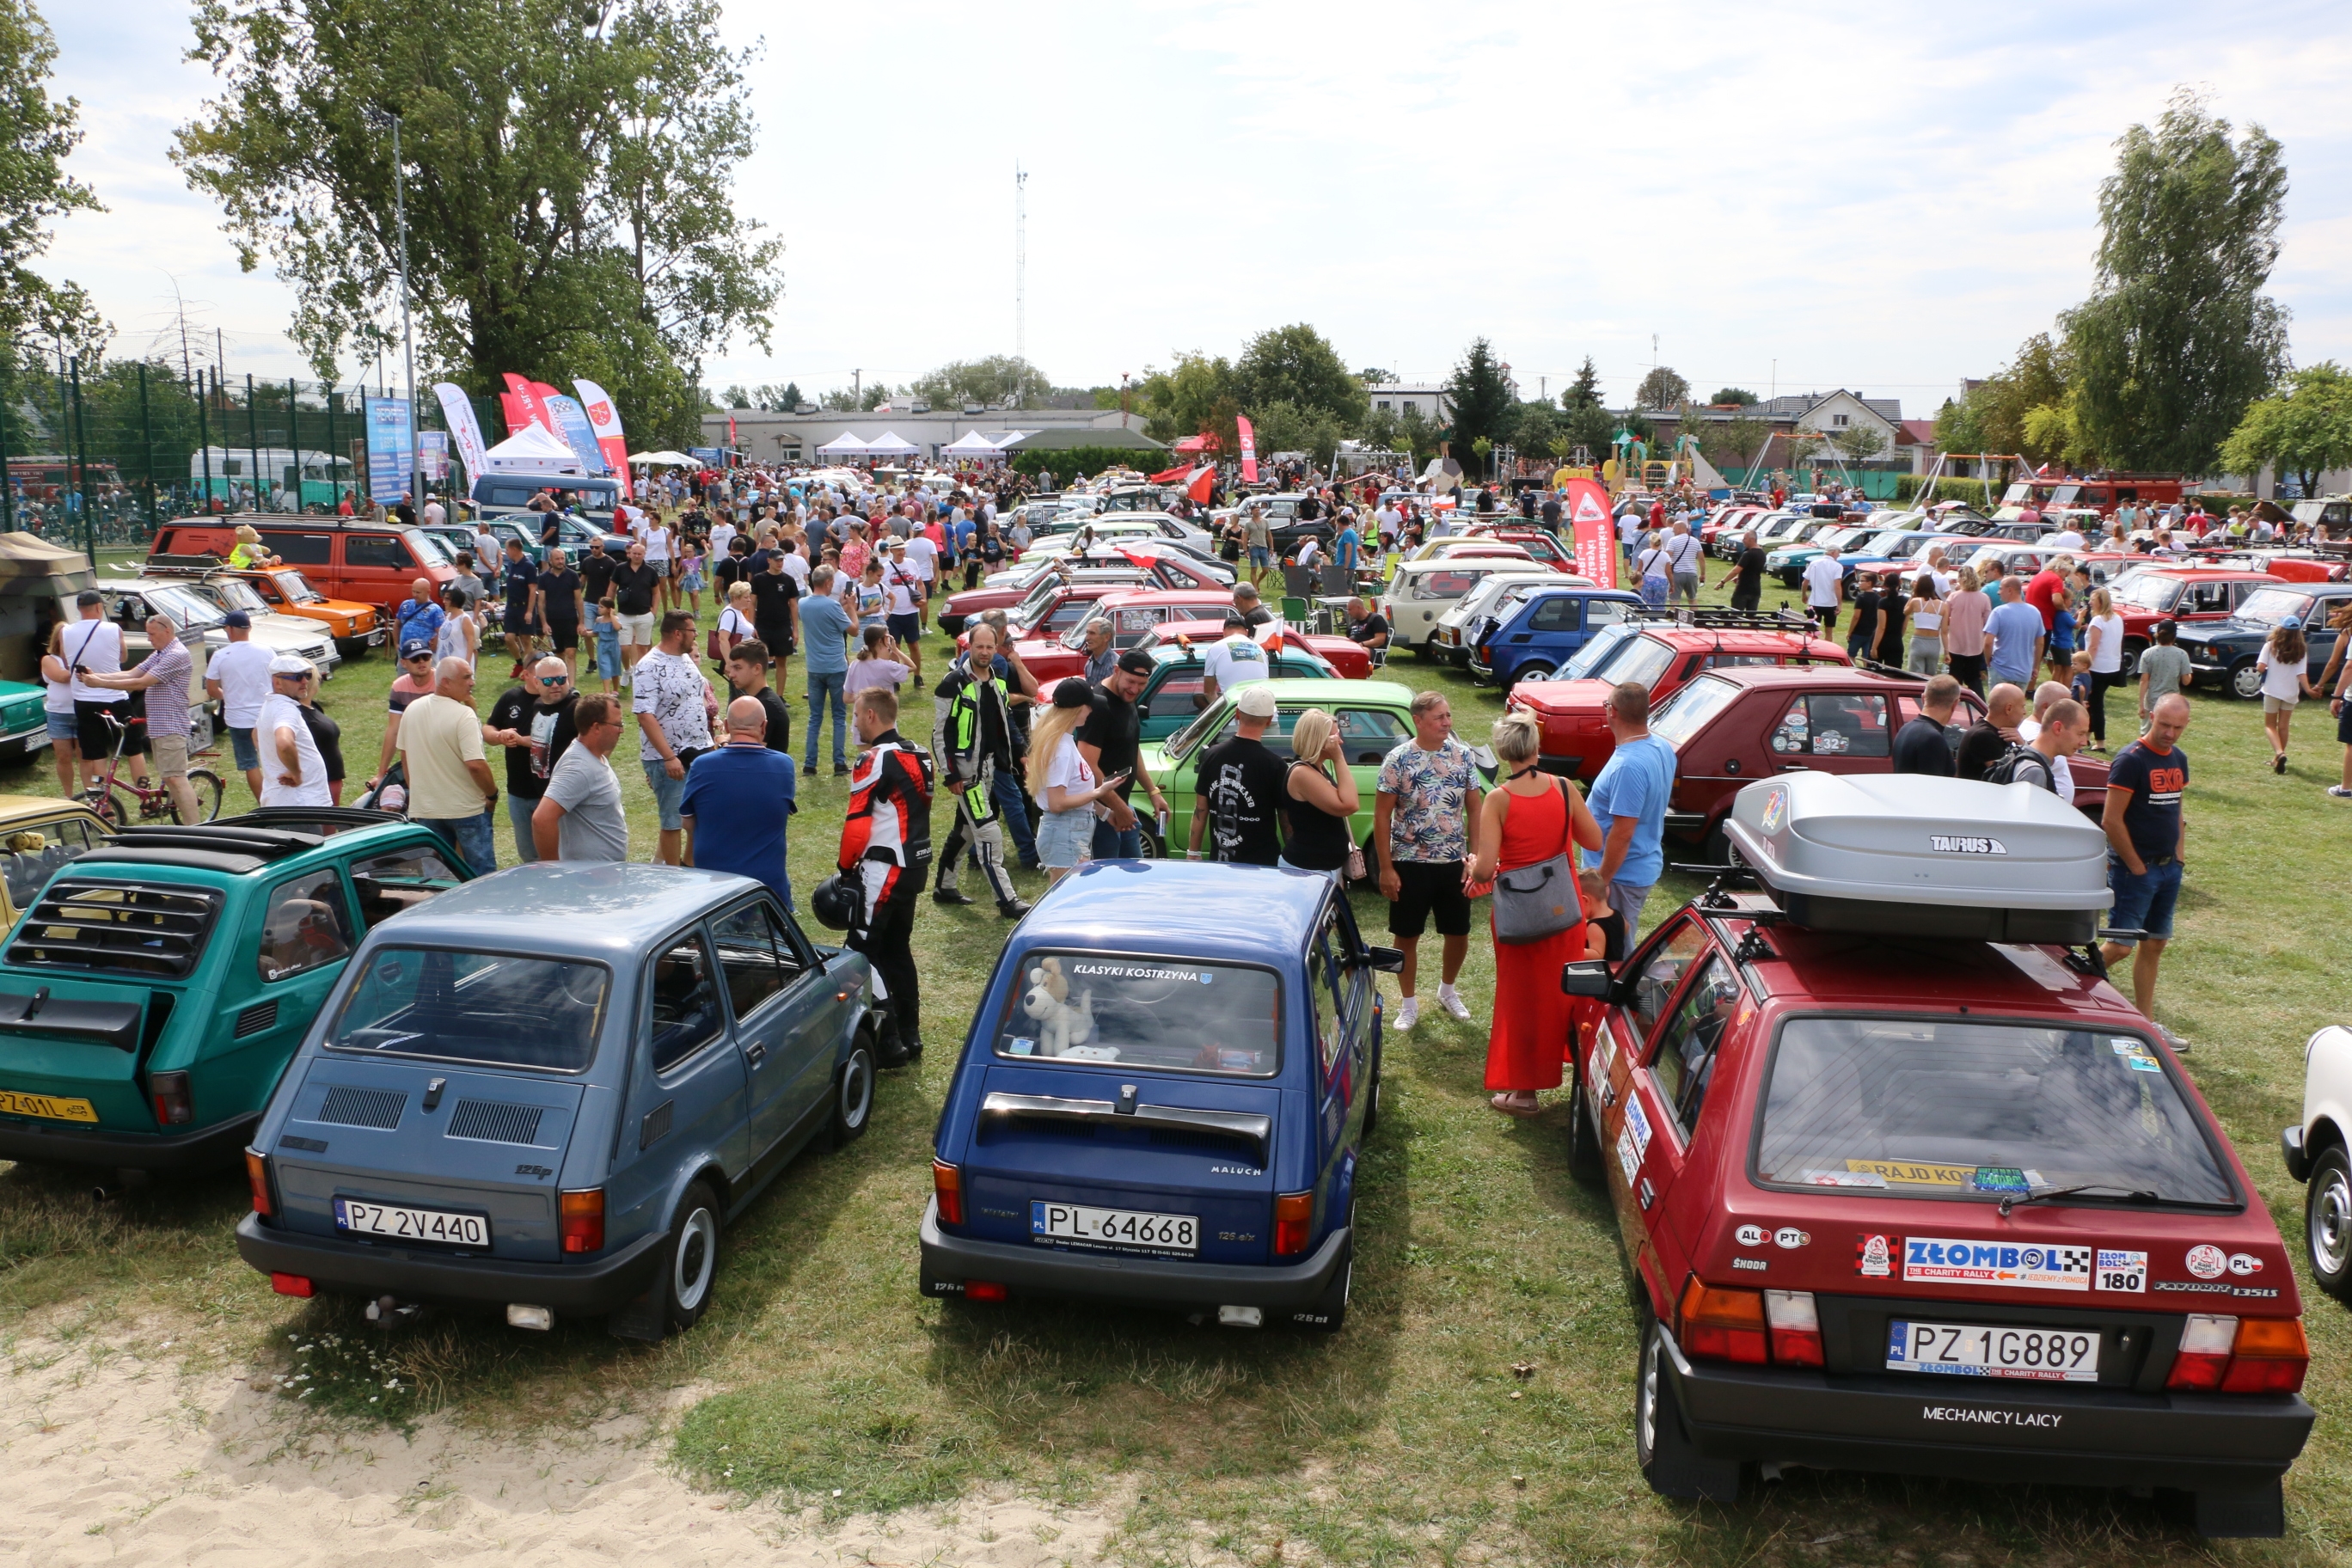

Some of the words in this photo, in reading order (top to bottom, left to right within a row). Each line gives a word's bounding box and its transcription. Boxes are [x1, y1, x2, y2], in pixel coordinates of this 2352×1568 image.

[28, 734, 38, 746] PSR
[1823, 738, 1839, 749] 32
[1231, 779, 1255, 808] POLAND
[1930, 836, 1988, 853] TAURUS
[1074, 965, 1124, 976] KLASYKI
[1126, 968, 1197, 981] KOSTRZYNA
[2141, 1058, 2157, 1067] 23
[27, 1098, 64, 1118] 01L
[515, 1164, 553, 1179] 126p
[1211, 1166, 1261, 1176] MALUCH
[1875, 1165, 1931, 1180] RAJD
[982, 1207, 1019, 1218] FIAT
[338, 1217, 347, 1226] PL
[351, 1204, 386, 1233] PZ
[395, 1211, 481, 1243] 2V440
[1034, 1221, 1044, 1229] PL
[1050, 1207, 1089, 1236] PL
[1102, 1214, 1193, 1245] 64668
[1218, 1231, 1236, 1240] 126
[1742, 1231, 1758, 1240] AL
[1780, 1233, 1797, 1242] PT
[1907, 1242, 2062, 1271] ZŁOMBOL
[1733, 1257, 1767, 1270] ŠKODA
[2233, 1260, 2249, 1269] PL
[1924, 1268, 1961, 1277] CHARITY
[1963, 1270, 1990, 1278] RALLY
[2103, 1273, 2140, 1290] 180
[2154, 1282, 2231, 1292] FAVORIT
[2233, 1288, 2278, 1298] 135LS
[1293, 1314, 1313, 1322] 126
[1890, 1345, 1904, 1356] PL
[1914, 1326, 1962, 1362] PZ
[1980, 1331, 2089, 1369] 1G889
[1919, 1363, 1979, 1375] ZŁOMBOL
[1923, 1406, 2013, 1424] MECHANICY
[2015, 1412, 2062, 1427] LAICY
